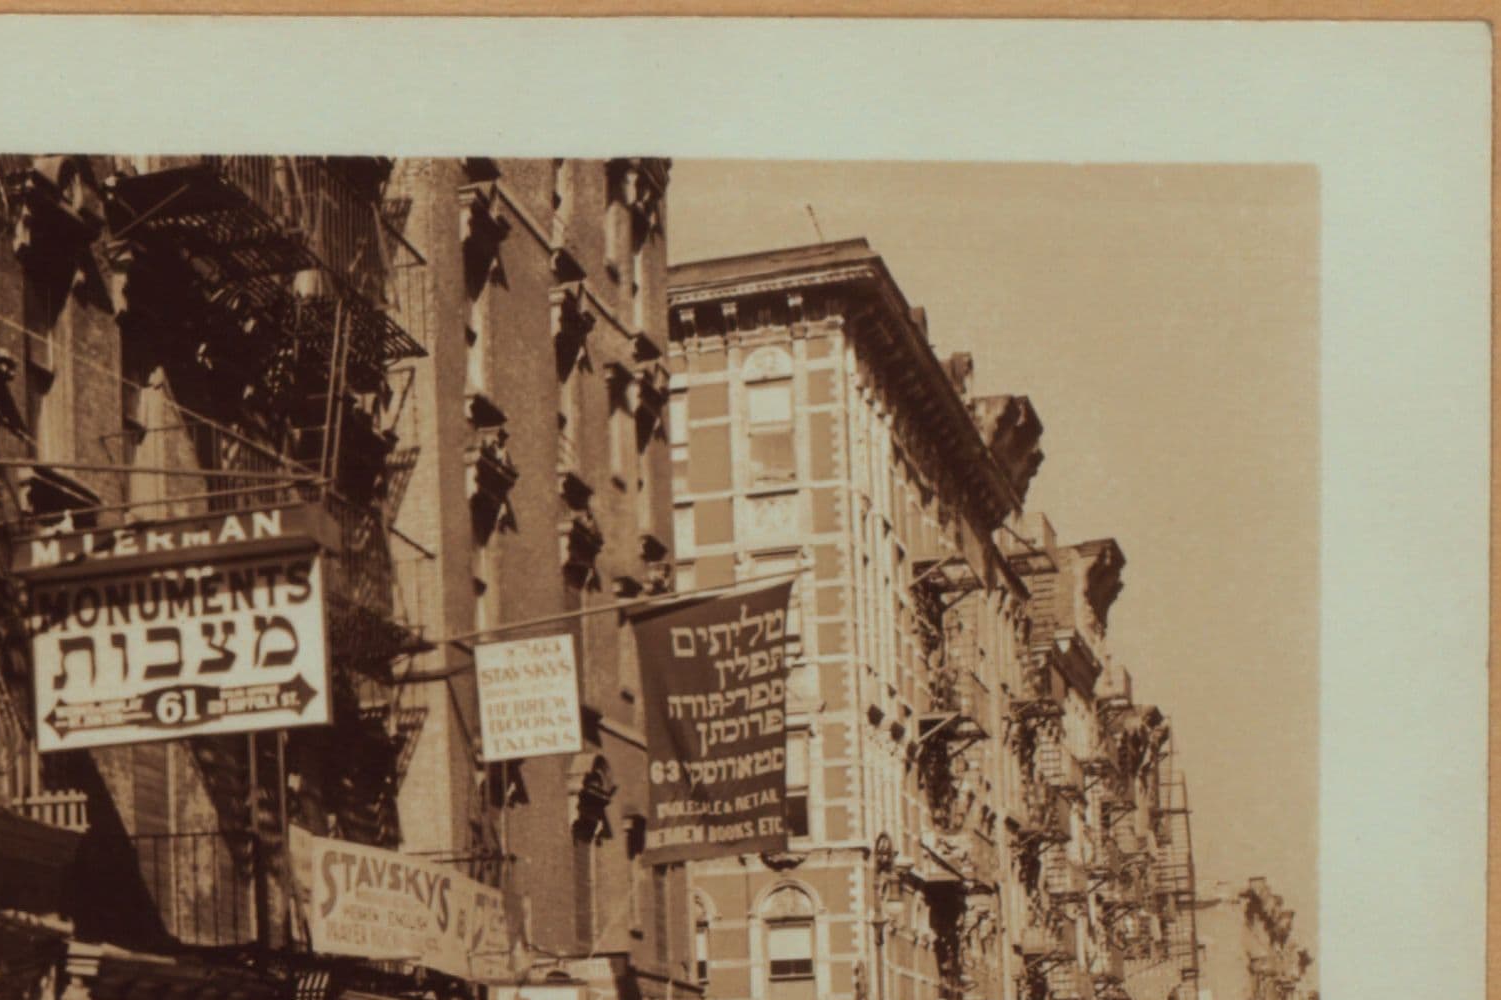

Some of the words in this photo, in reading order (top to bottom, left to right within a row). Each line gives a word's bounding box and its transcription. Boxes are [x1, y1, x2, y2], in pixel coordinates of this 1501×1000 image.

[34, 560, 312, 632] MONUMENTS
[51, 613, 301, 692] מצבות
[668, 602, 785, 660] טליתים
[712, 646, 785, 694] תפלין
[155, 688, 201, 725] 61
[695, 709, 785, 760] פרוכתן
[649, 760, 682, 786] 63
[708, 821, 756, 844] BOOKS
[320, 850, 452, 936] STAVSKYS
